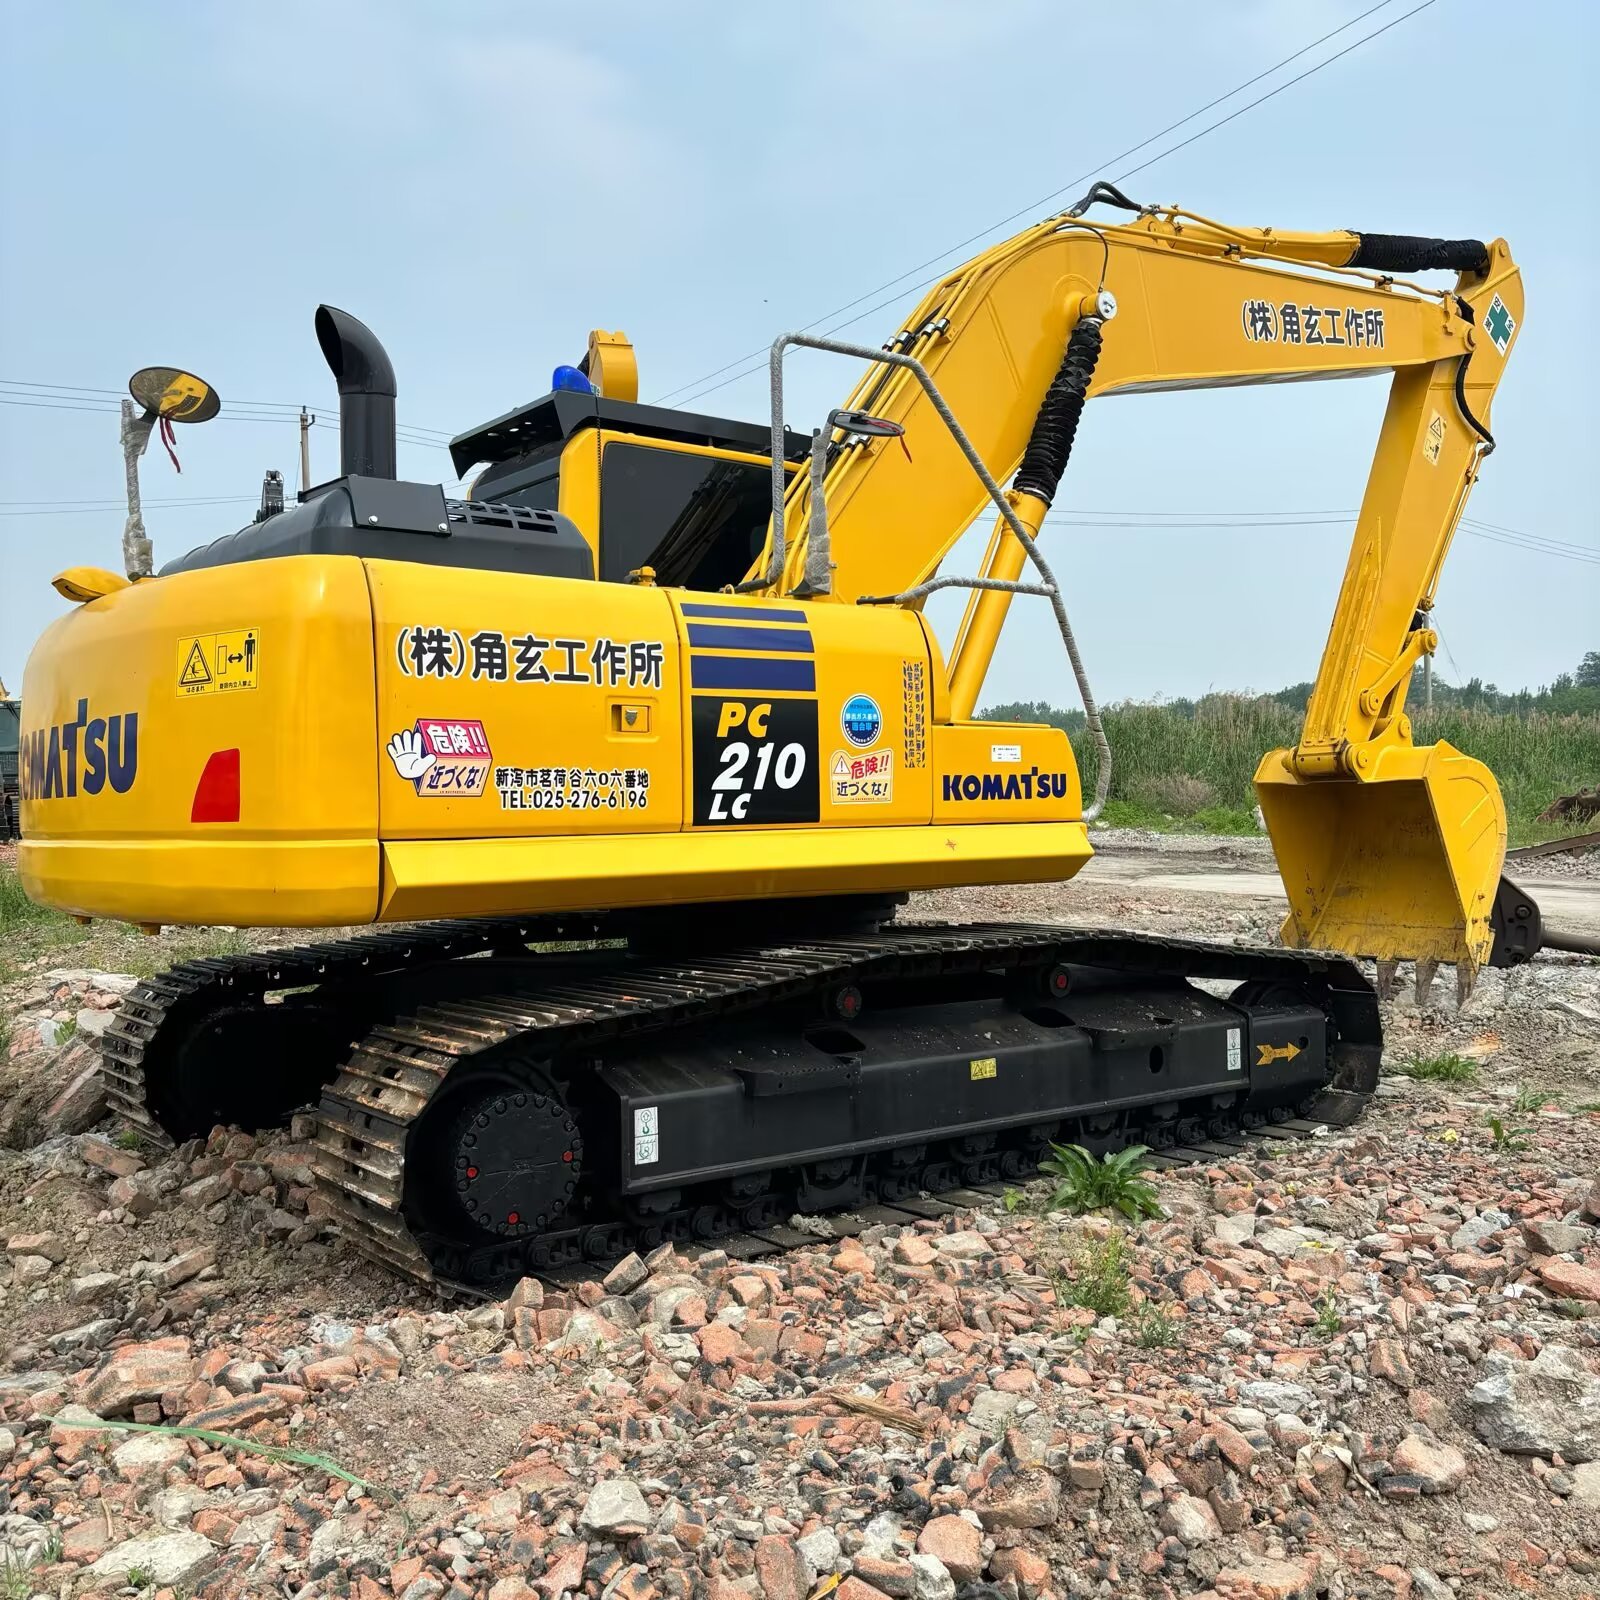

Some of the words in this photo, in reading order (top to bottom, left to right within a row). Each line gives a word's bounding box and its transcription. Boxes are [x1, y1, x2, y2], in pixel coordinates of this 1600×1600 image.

[1243, 300, 1384, 348] (株)角玄工作所
[397, 627, 664, 688] (株)角玄工作所
[717, 702, 772, 738] PC
[20, 698, 138, 800] OMATSU
[426, 723, 488, 755] 危険!!
[426, 765, 487, 790] 近づくな!
[711, 741, 806, 791] 210
[851, 754, 890, 780] 危険!!
[500, 790, 647, 809] TEL:025-276-6196
[837, 781, 888, 797] 近づくな!
[942, 766, 1067, 802] KOMATSU
[708, 792, 752, 820] LC
